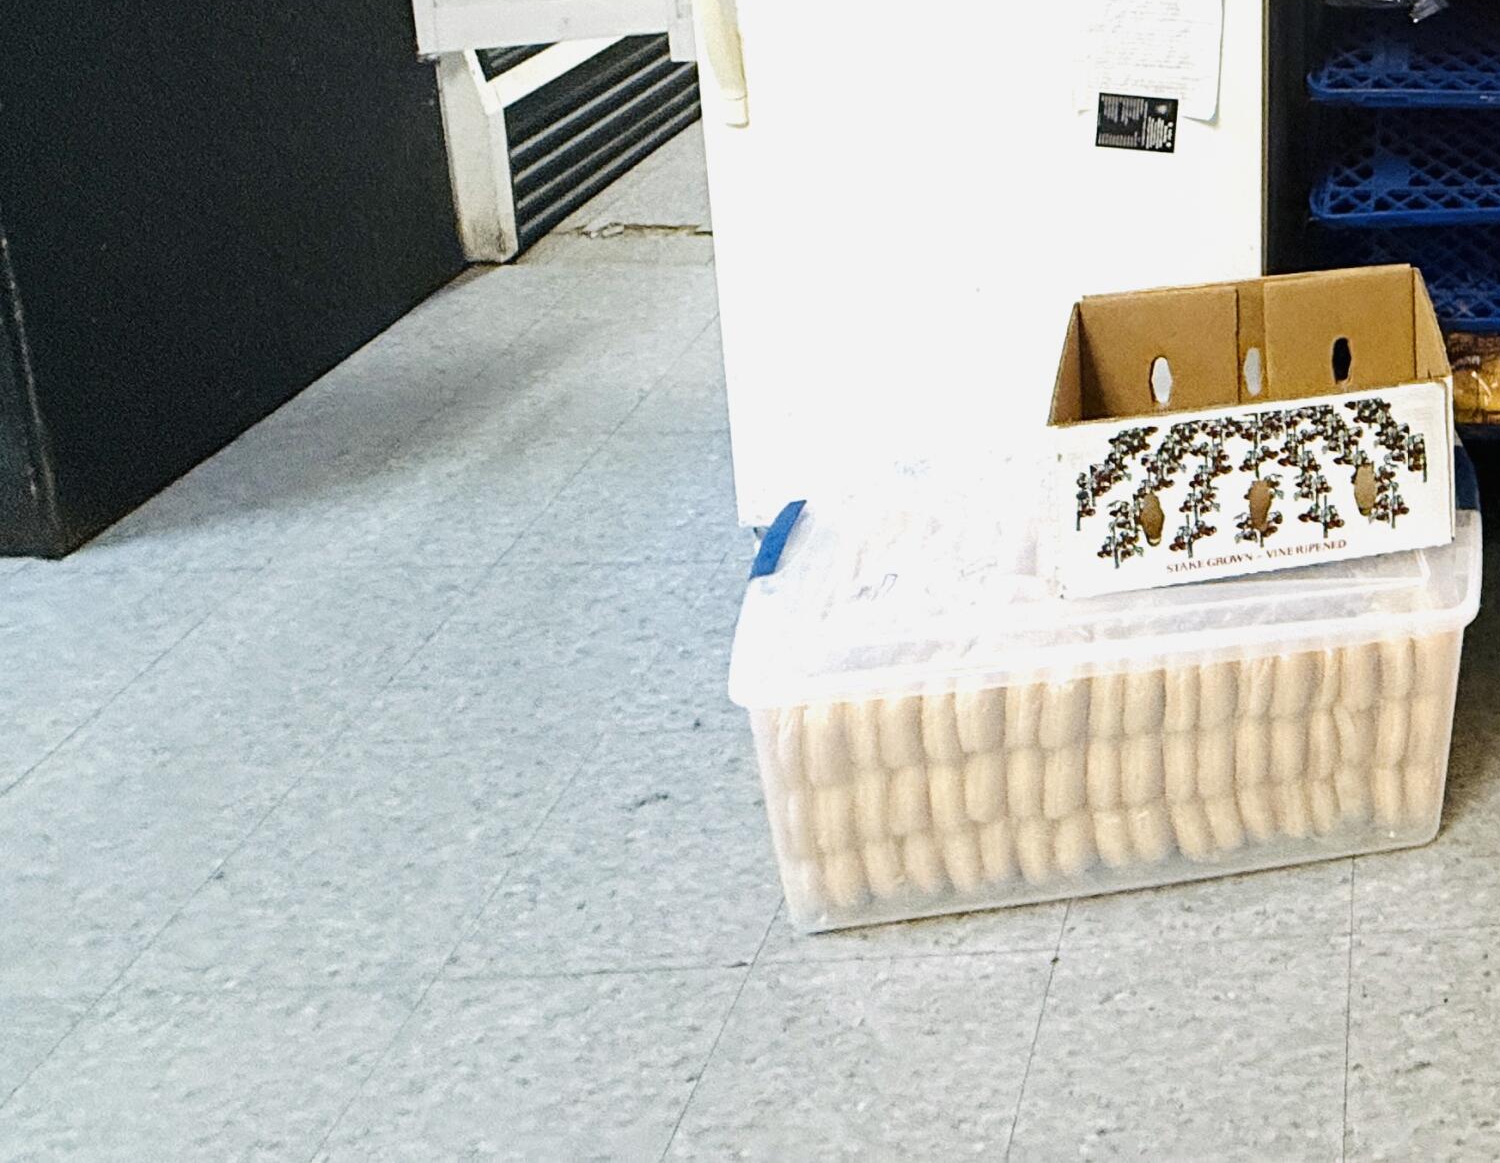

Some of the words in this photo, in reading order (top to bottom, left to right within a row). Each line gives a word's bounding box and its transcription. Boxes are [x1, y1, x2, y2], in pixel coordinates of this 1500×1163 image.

[1166, 557, 1203, 574] STAKE
[1206, 553, 1254, 569] GROWN
[1265, 546, 1293, 559] VINE
